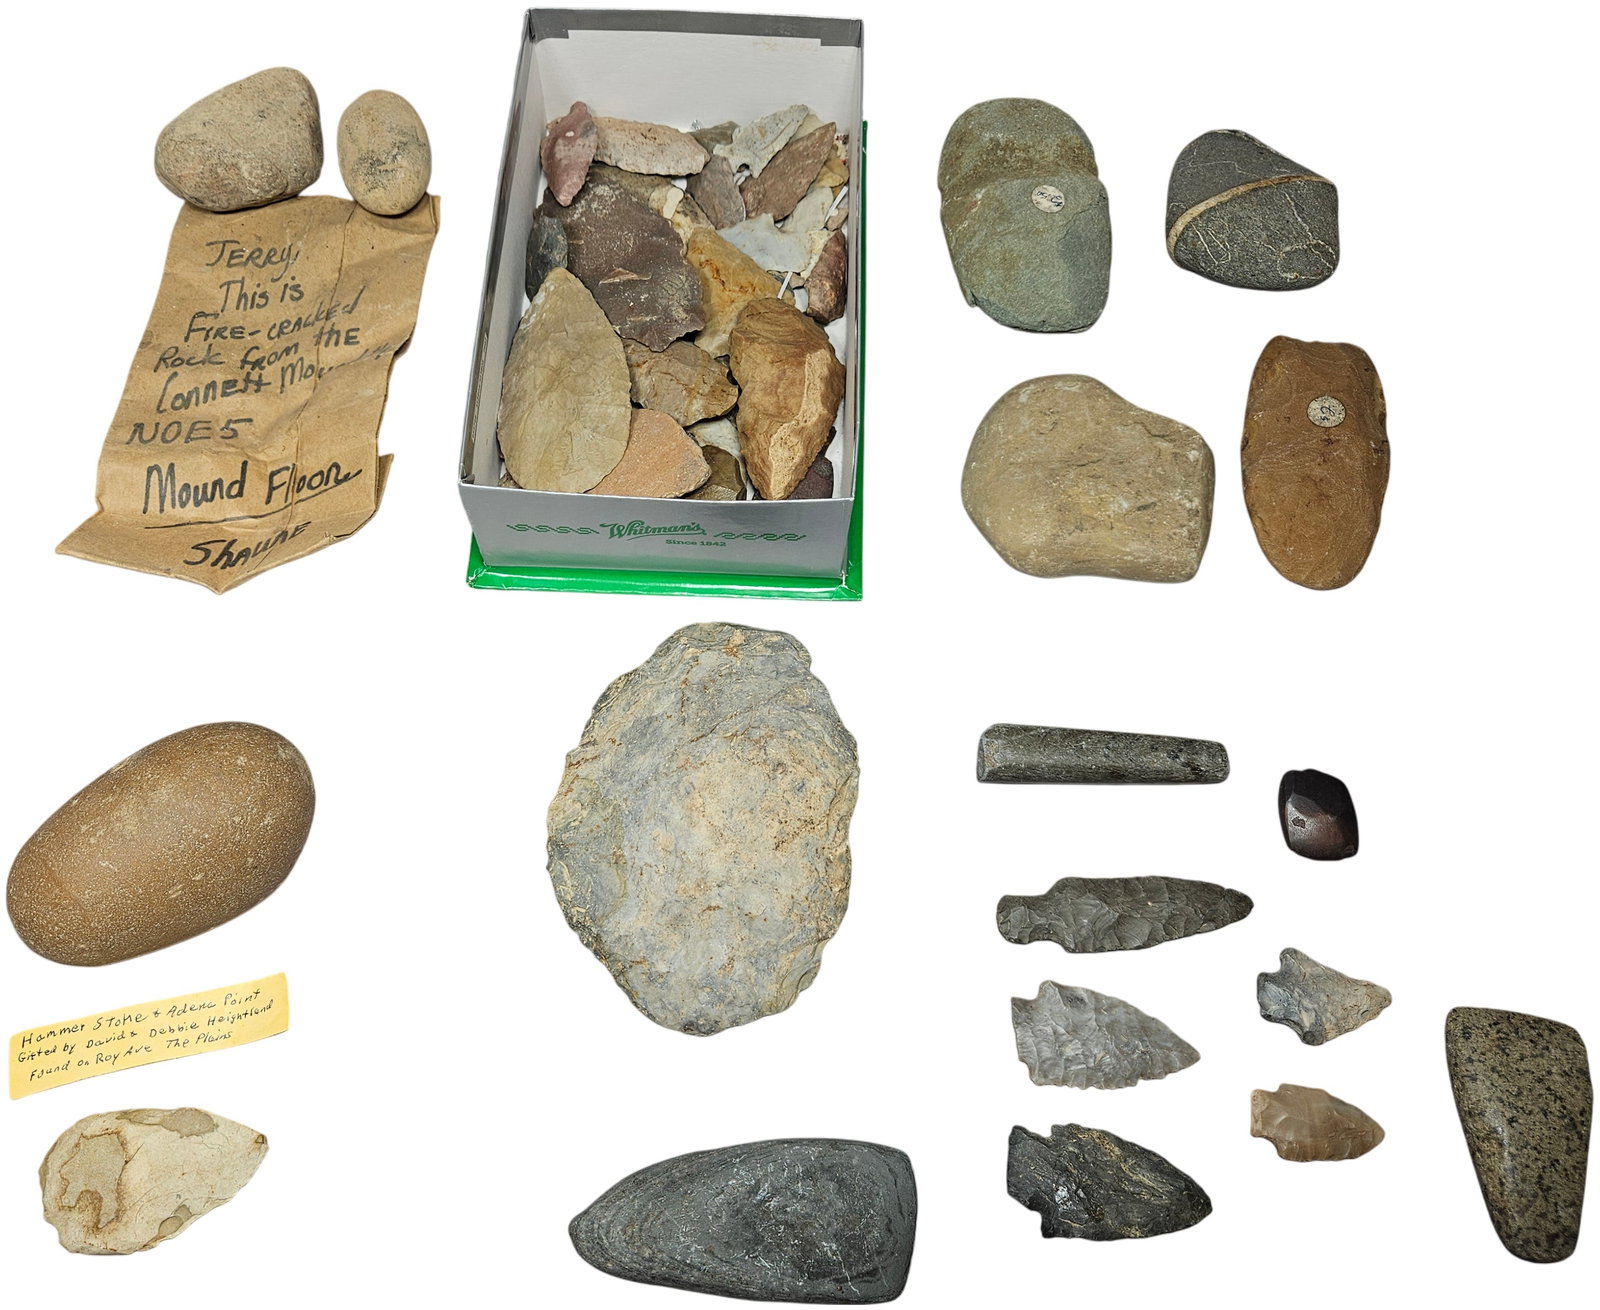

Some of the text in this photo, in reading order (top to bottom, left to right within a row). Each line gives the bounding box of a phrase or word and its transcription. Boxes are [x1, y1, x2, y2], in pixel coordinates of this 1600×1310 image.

[219, 276, 304, 312] This is
[152, 343, 226, 372] Rock
[142, 459, 249, 514] Mound
[599, 519, 707, 541] Whitman's
[22, 1023, 85, 1048] Hammer
[166, 1000, 217, 1018] Adena
[223, 988, 261, 1006] Point
[17, 1045, 58, 1063] Gifted
[62, 1042, 77, 1055] by
[85, 1030, 127, 1049] David
[149, 1021, 200, 1038] Debbie
[95, 1051, 121, 1066] Roy
[123, 1045, 153, 1058] Ave
[166, 1038, 190, 1050] The
[195, 1028, 234, 1045] Plains
